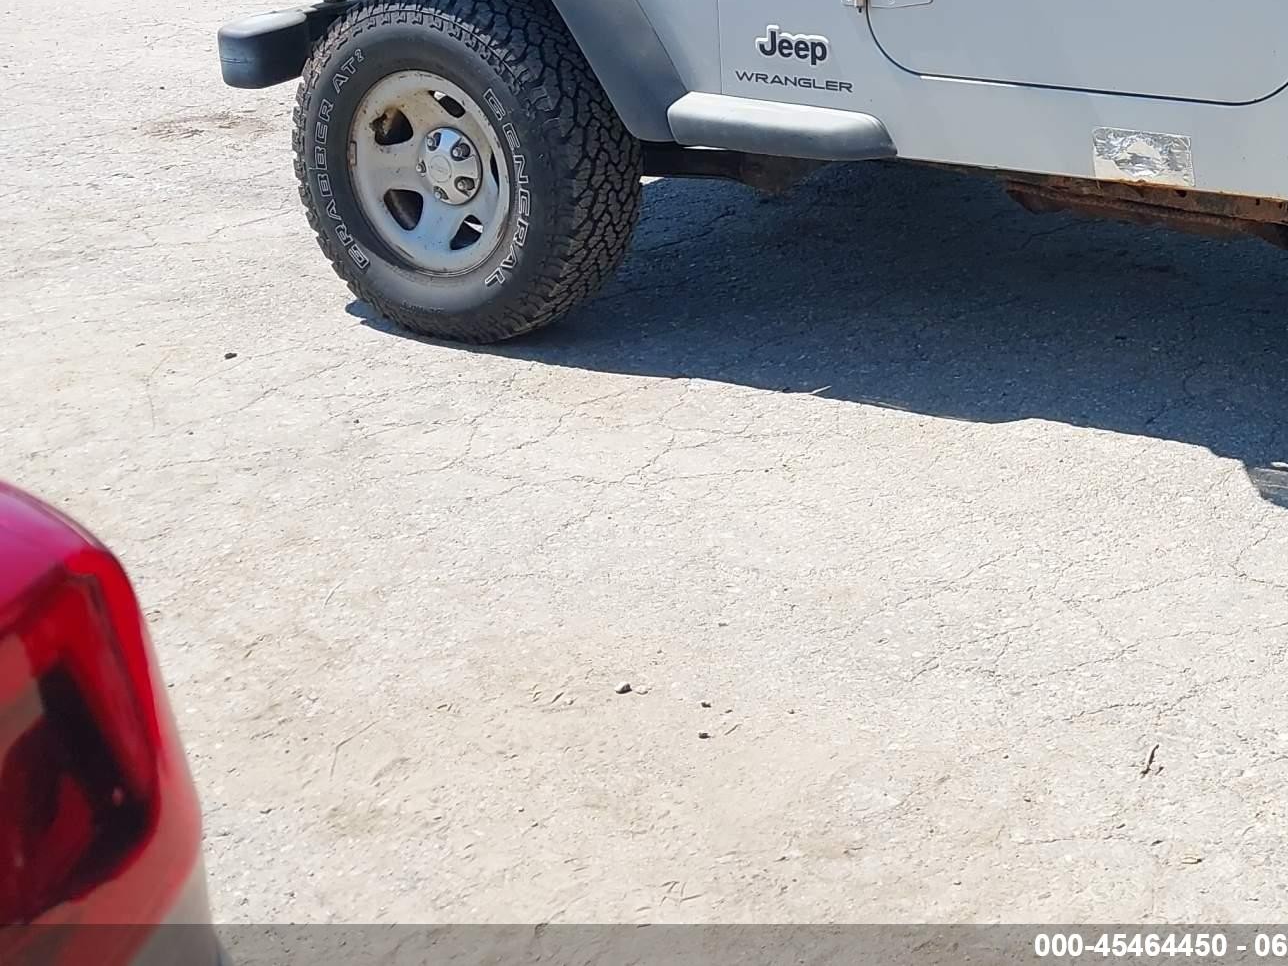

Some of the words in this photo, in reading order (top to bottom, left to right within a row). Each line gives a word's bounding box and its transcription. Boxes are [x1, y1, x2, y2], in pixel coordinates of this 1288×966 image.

[735, 69, 853, 94] WRANGLER
[758, 29, 828, 66] Jeep
[312, 98, 371, 271] GRABBER
[483, 88, 532, 288] GENERAL
